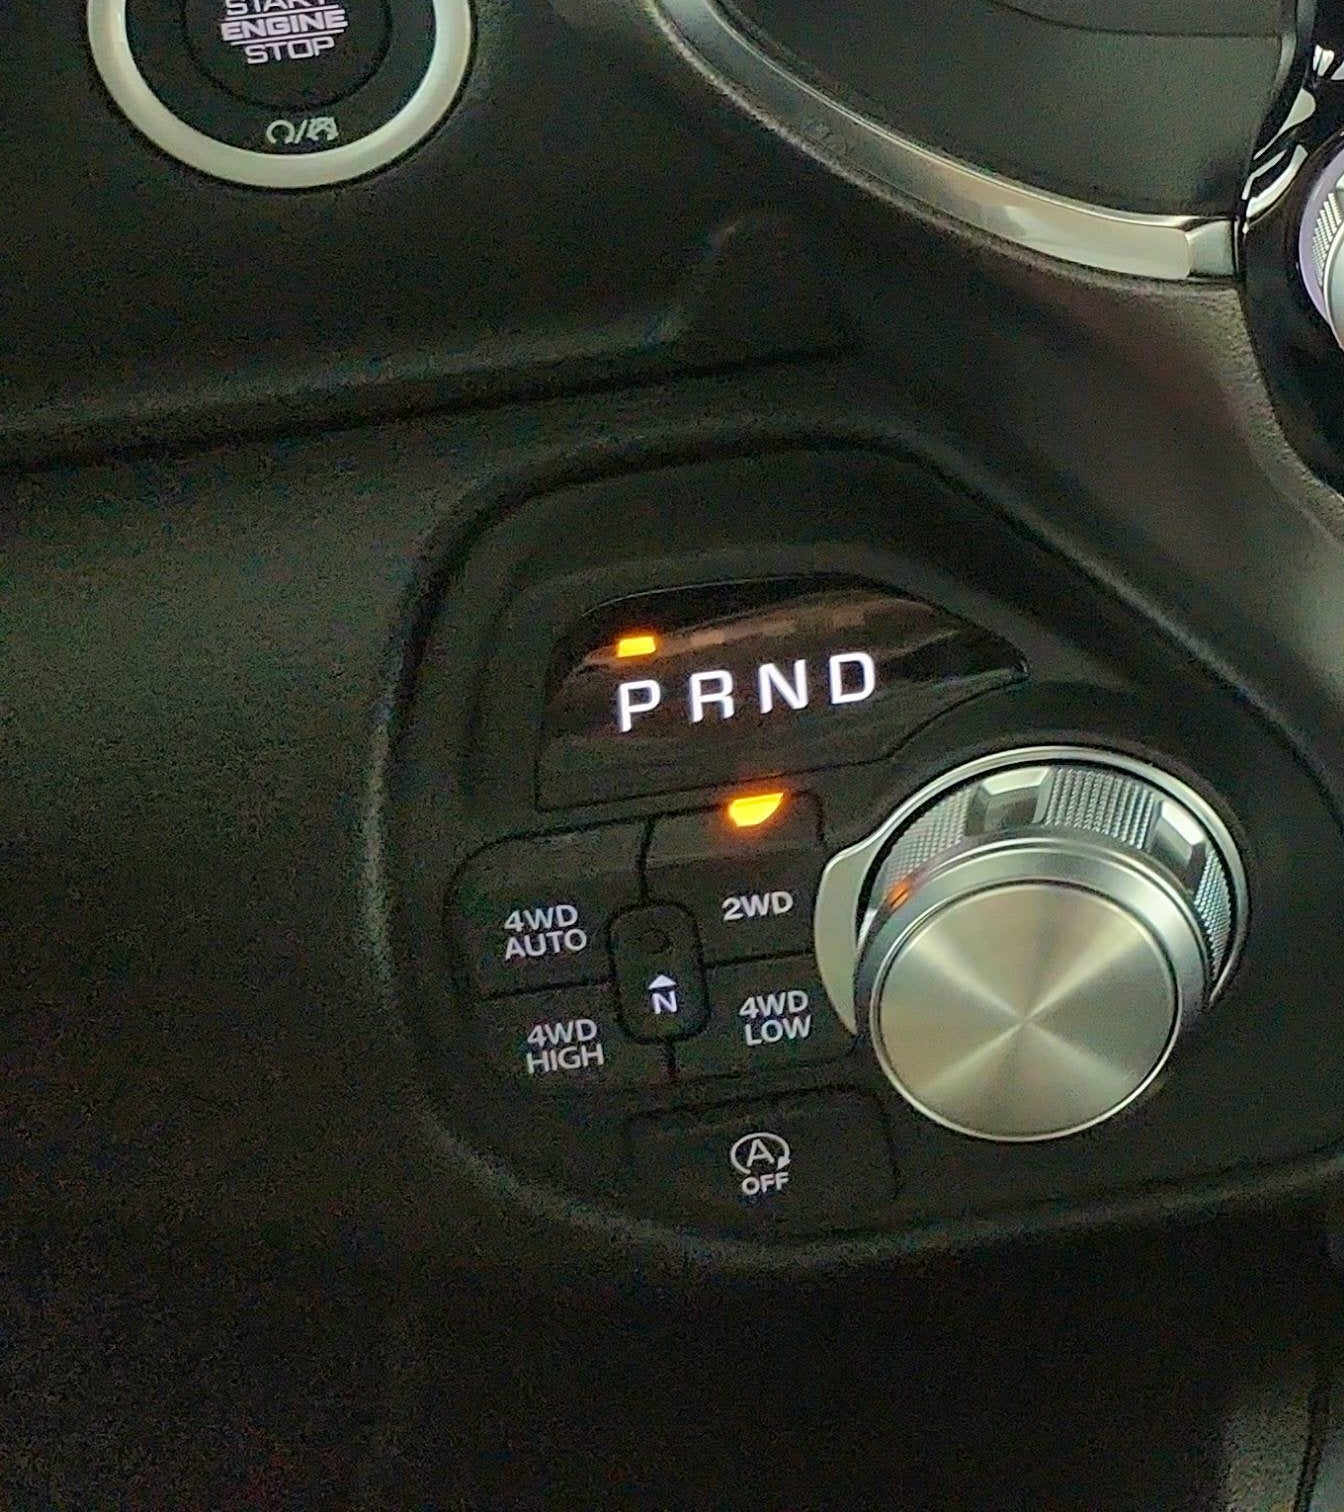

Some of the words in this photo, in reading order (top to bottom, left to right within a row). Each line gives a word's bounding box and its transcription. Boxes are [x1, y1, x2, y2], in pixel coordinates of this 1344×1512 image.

[221, 9, 348, 42] ENGINE
[244, 36, 334, 65] STOP
[503, 904, 579, 934] 4WD
[722, 890, 793, 922] 2WD
[503, 929, 588, 960] AUTO
[651, 990, 678, 1014] N
[738, 991, 809, 1020] 4WD
[526, 1019, 598, 1047] 4WD
[744, 1015, 812, 1046] LOW
[526, 1043, 604, 1074] HIGH
[741, 1172, 790, 1195] OFF
